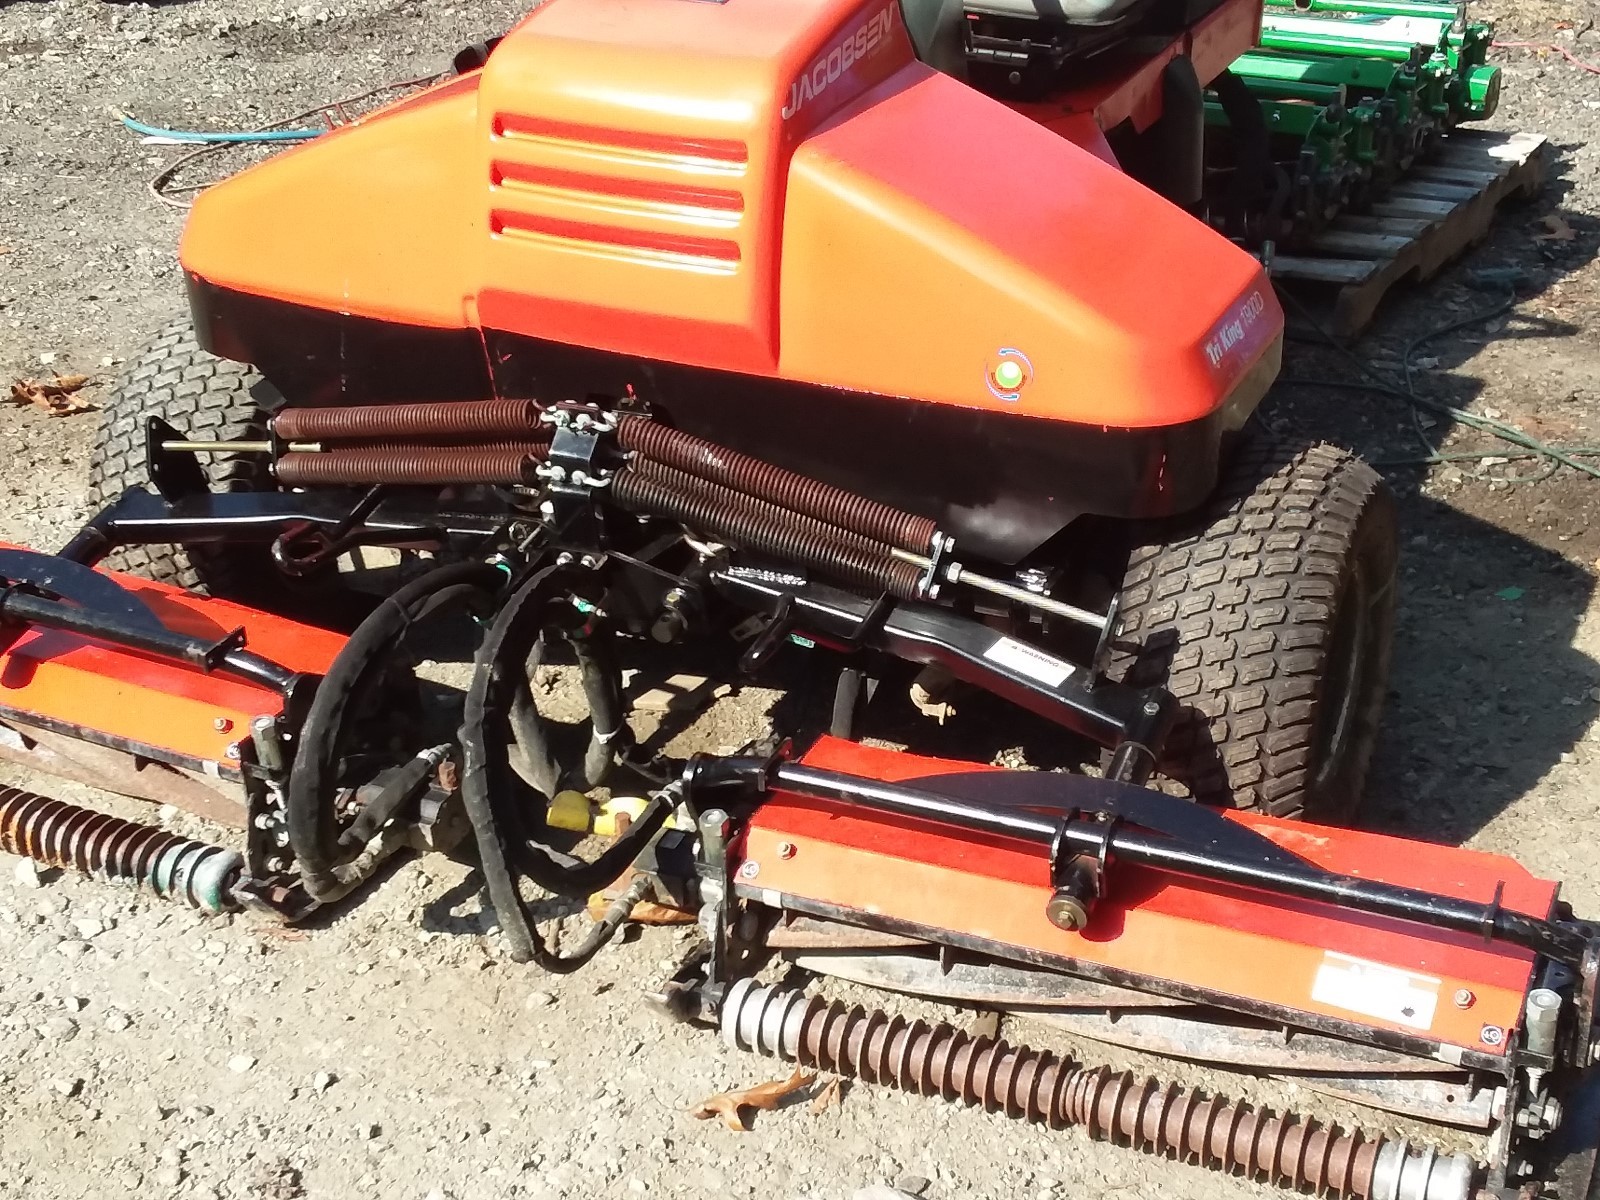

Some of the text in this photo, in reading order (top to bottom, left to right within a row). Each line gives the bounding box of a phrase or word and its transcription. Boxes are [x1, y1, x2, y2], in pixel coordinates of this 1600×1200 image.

[782, 0, 897, 120] JACOBSEN
[1206, 337, 1223, 366] Tri
[1219, 319, 1245, 351] King
